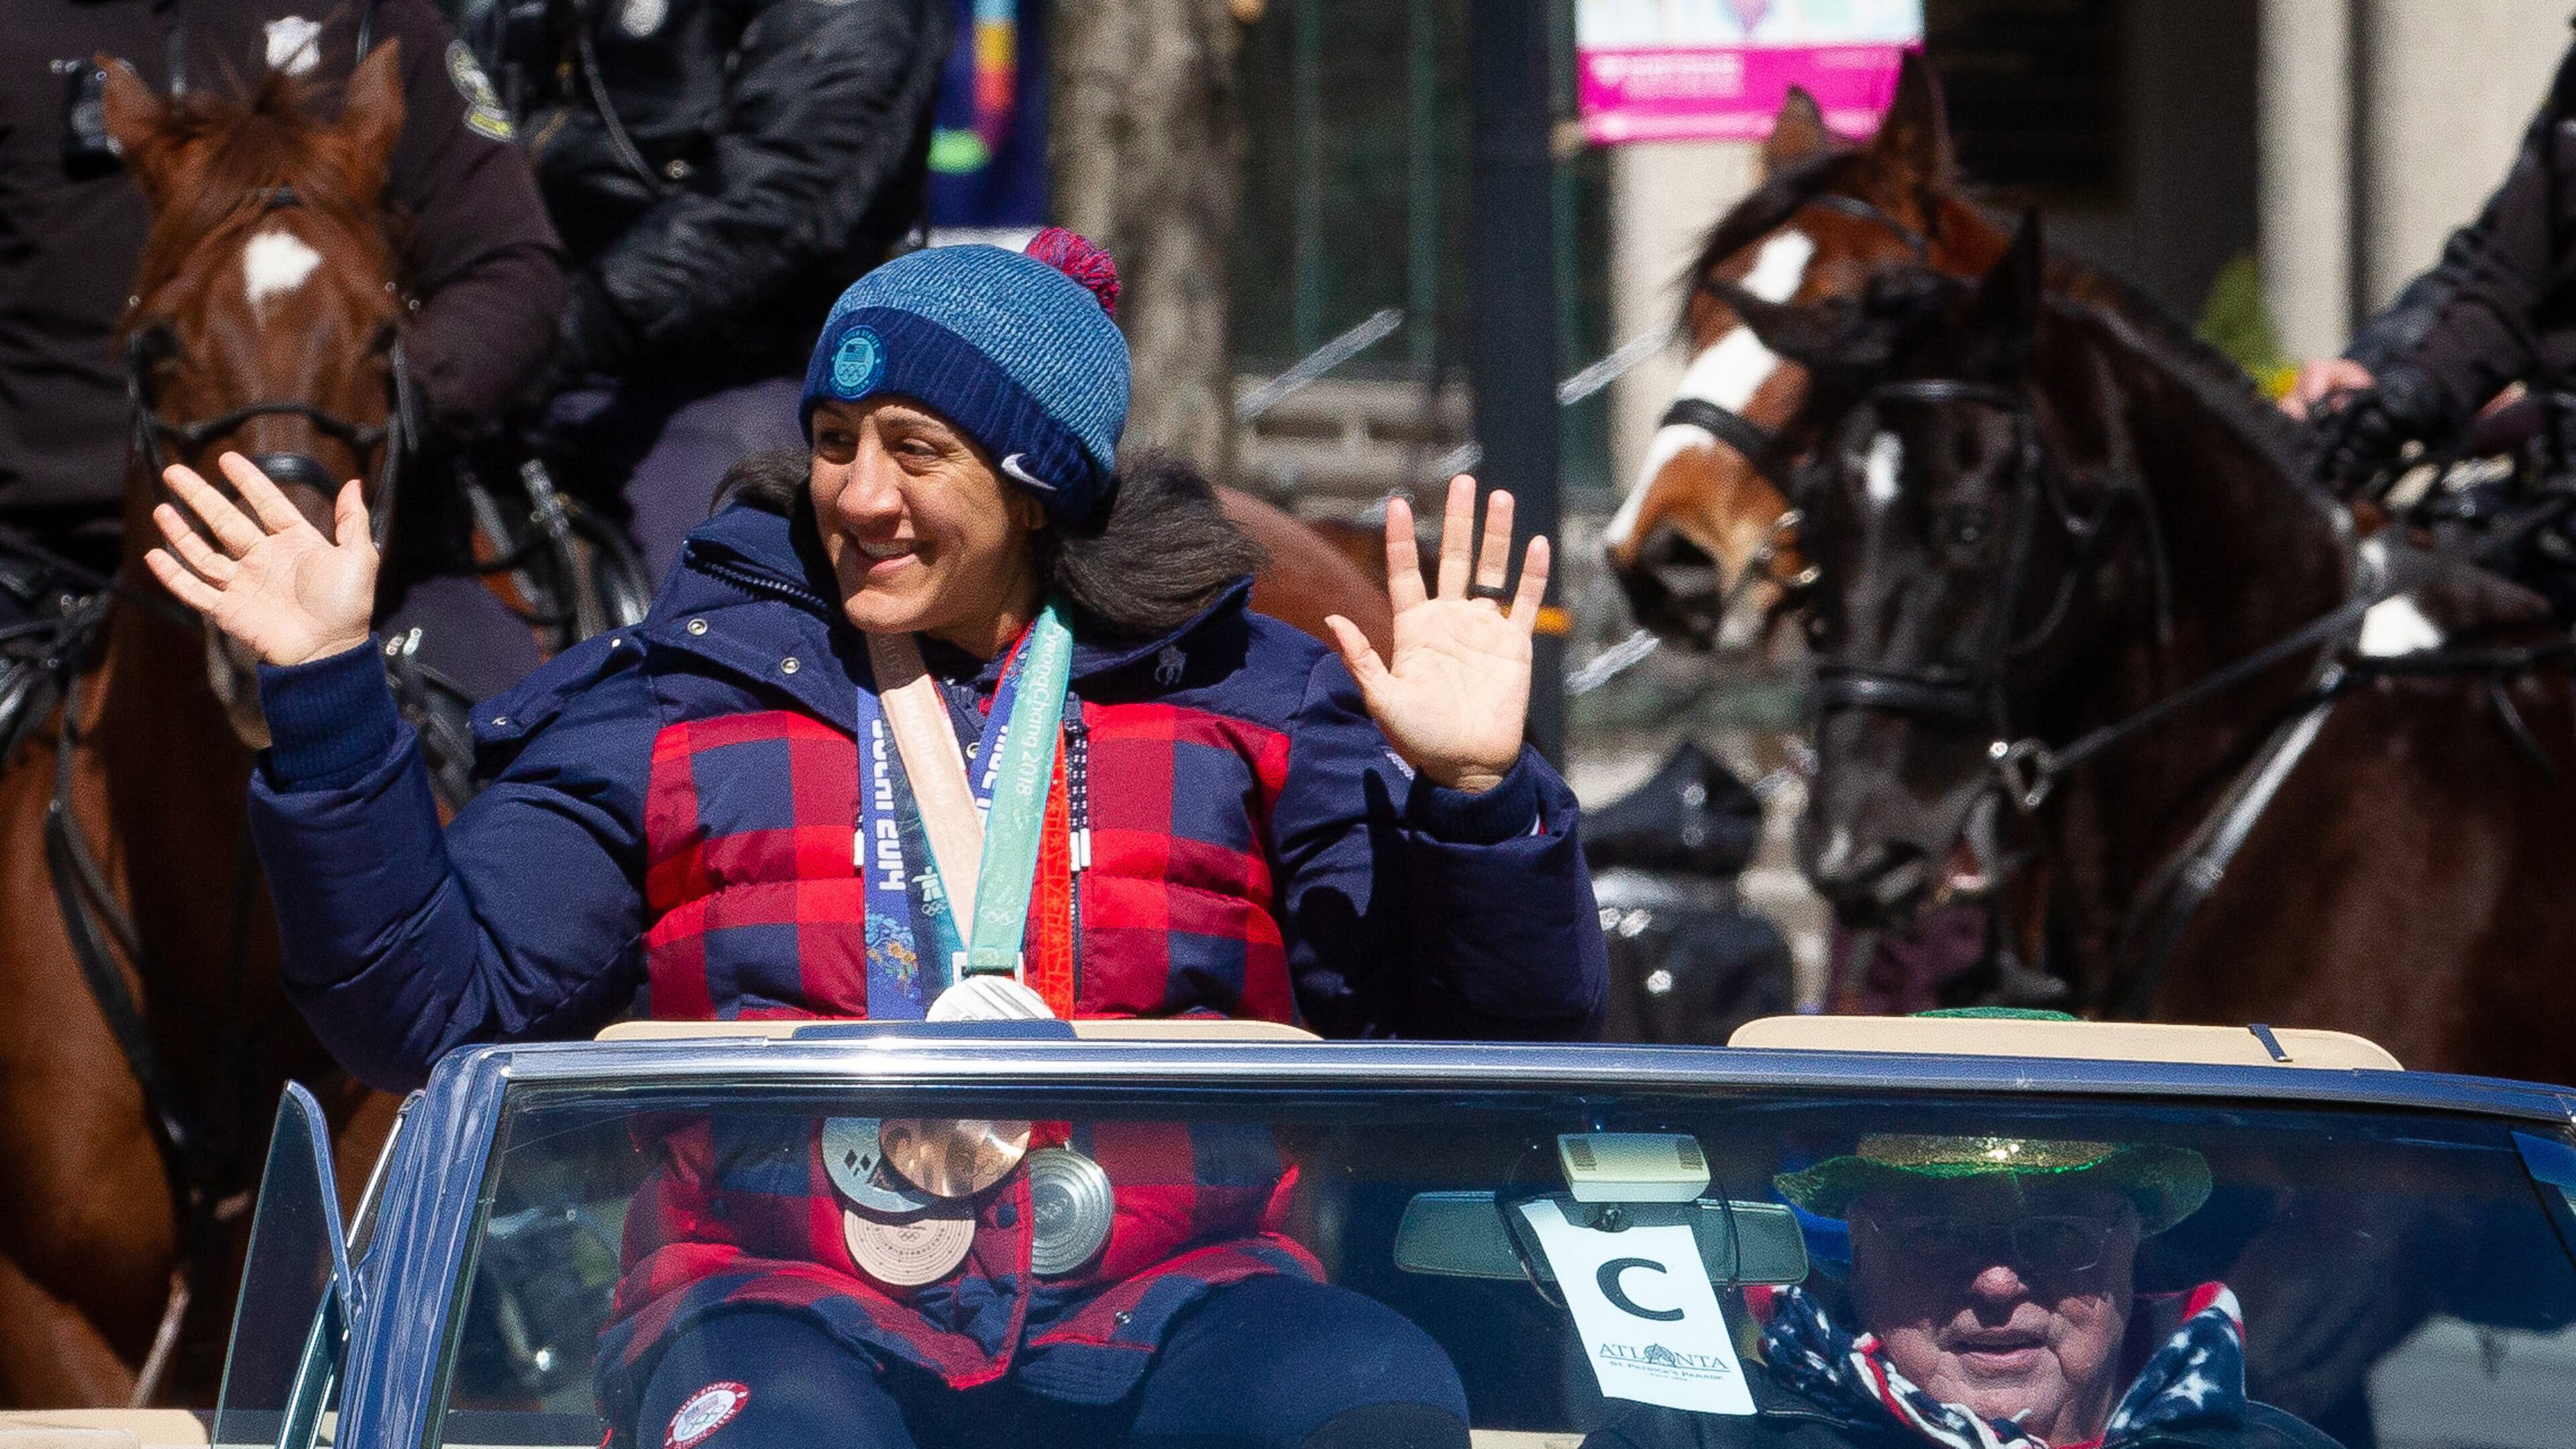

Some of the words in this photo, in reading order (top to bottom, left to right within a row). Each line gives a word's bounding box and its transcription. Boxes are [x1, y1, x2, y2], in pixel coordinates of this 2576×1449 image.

[1015, 750, 1039, 796] 2018
[1596, 1257, 1684, 1321] C
[1600, 1343, 1728, 1368] ATLANTA
